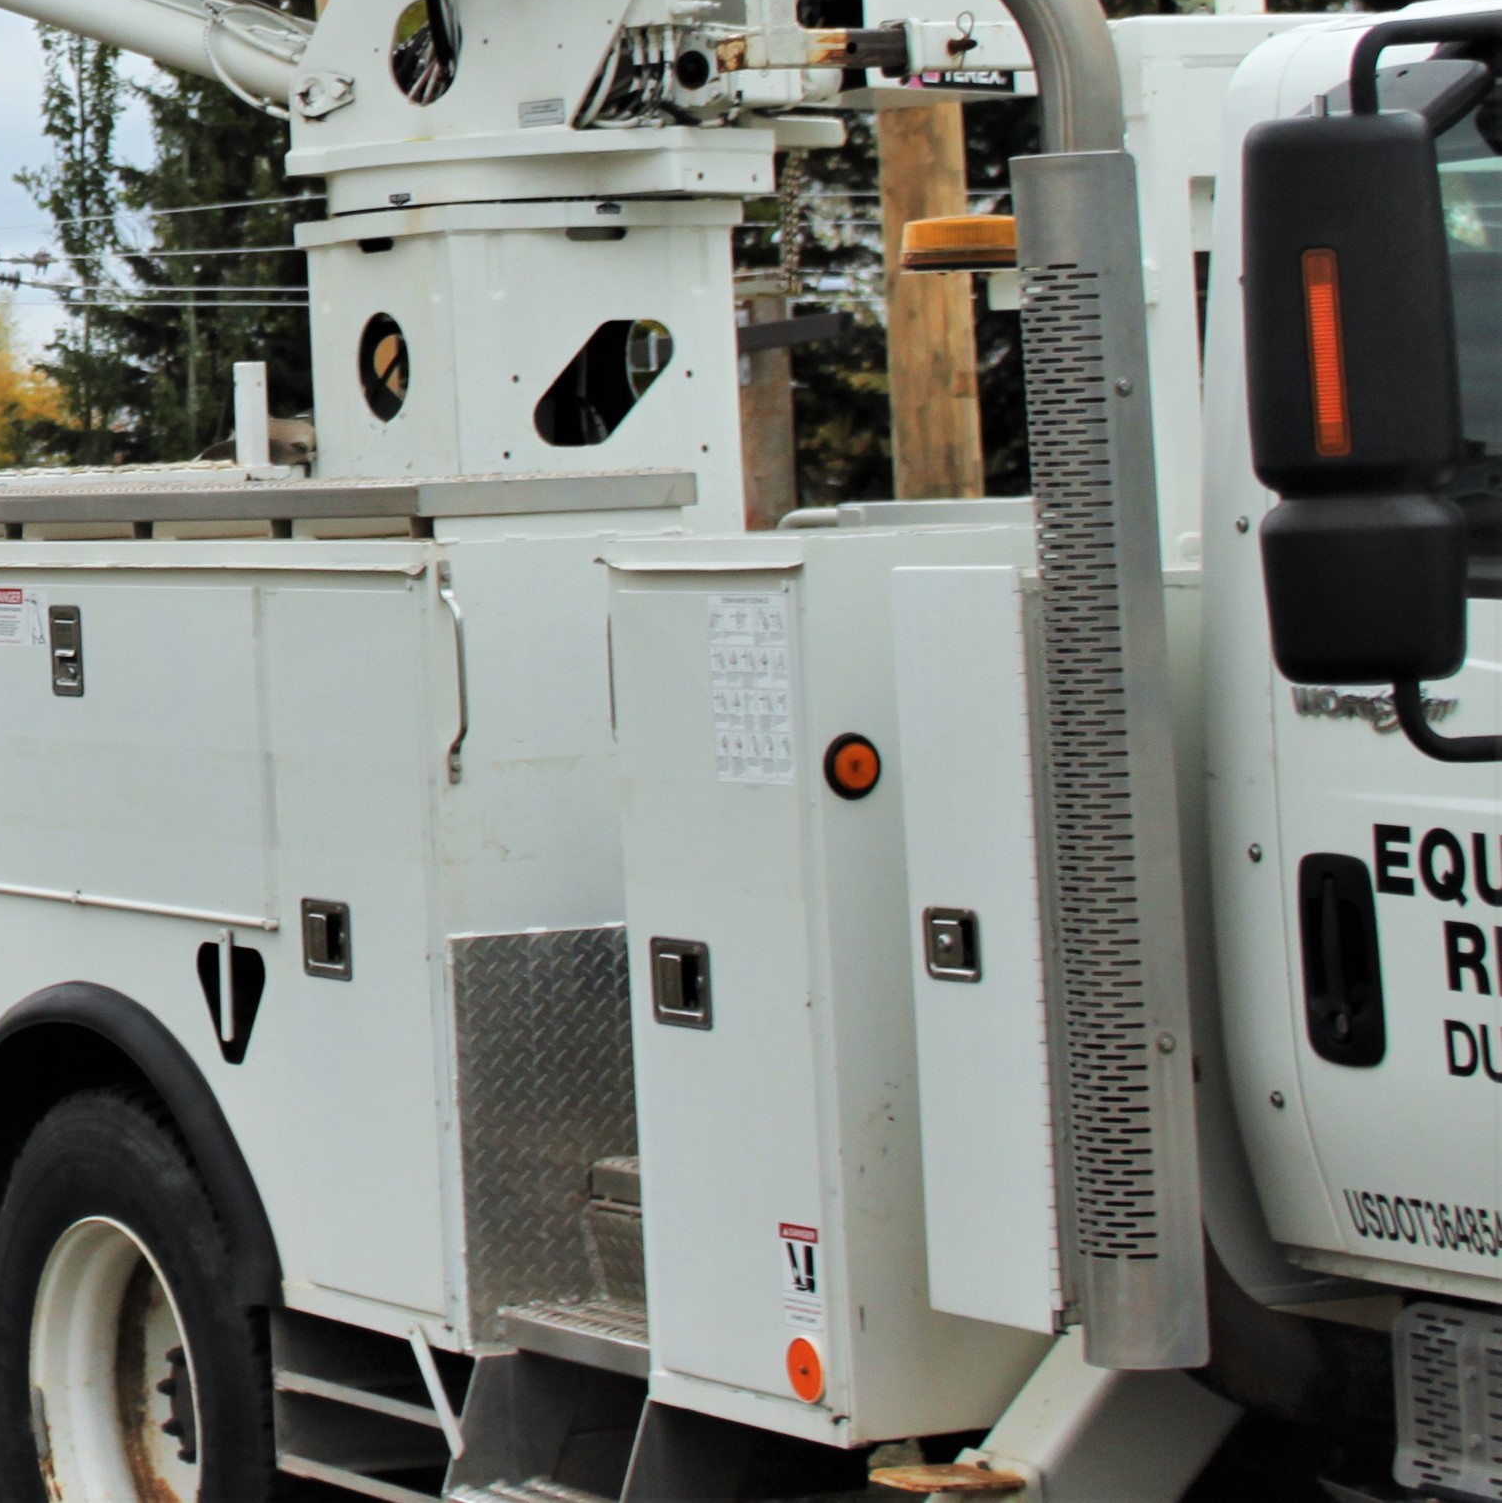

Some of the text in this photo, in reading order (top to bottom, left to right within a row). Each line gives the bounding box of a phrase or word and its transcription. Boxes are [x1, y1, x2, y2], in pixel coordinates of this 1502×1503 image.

[1372, 823, 1502, 907] EQU
[1442, 920, 1502, 996] R
[1443, 1019, 1502, 1083] DU
